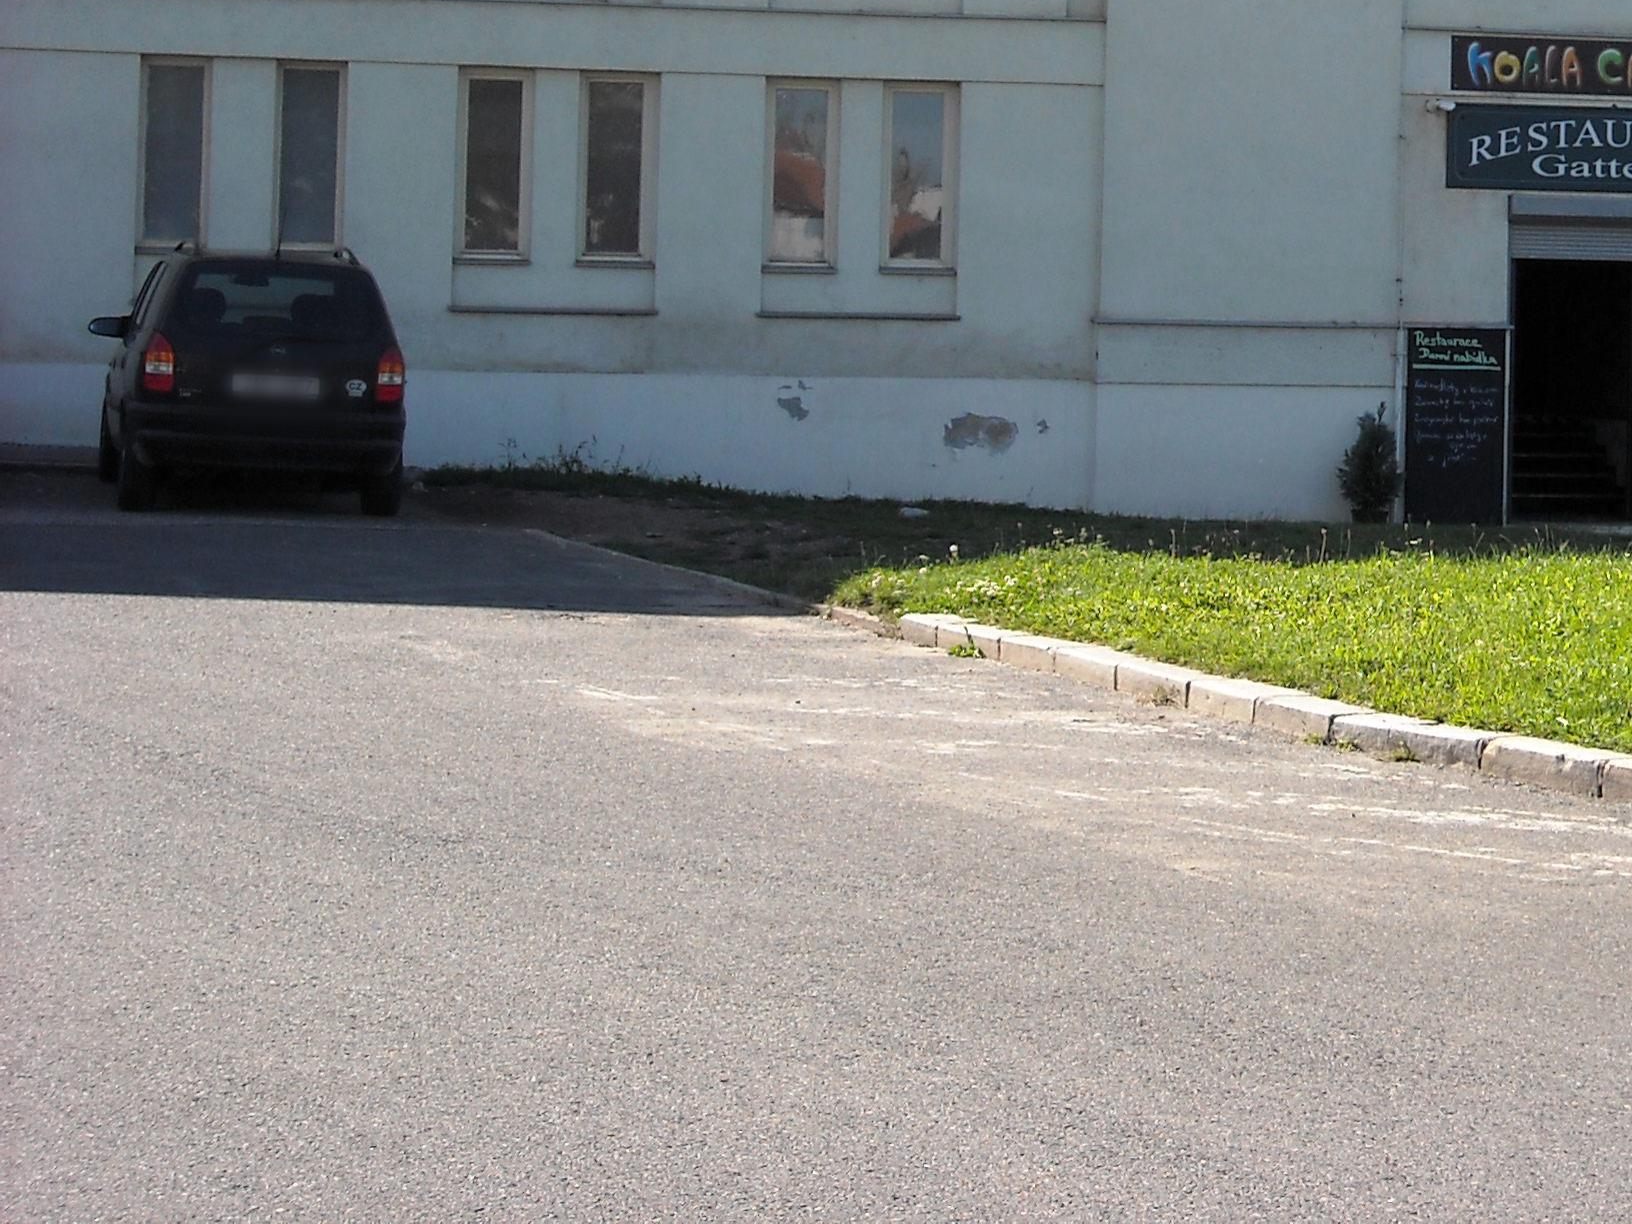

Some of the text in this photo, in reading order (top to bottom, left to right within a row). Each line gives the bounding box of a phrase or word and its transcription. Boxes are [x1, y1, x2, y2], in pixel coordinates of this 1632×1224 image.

[1467, 41, 1583, 89] KOALA
[1414, 330, 1482, 347] Restaurace
[349, 382, 362, 390] CZ
